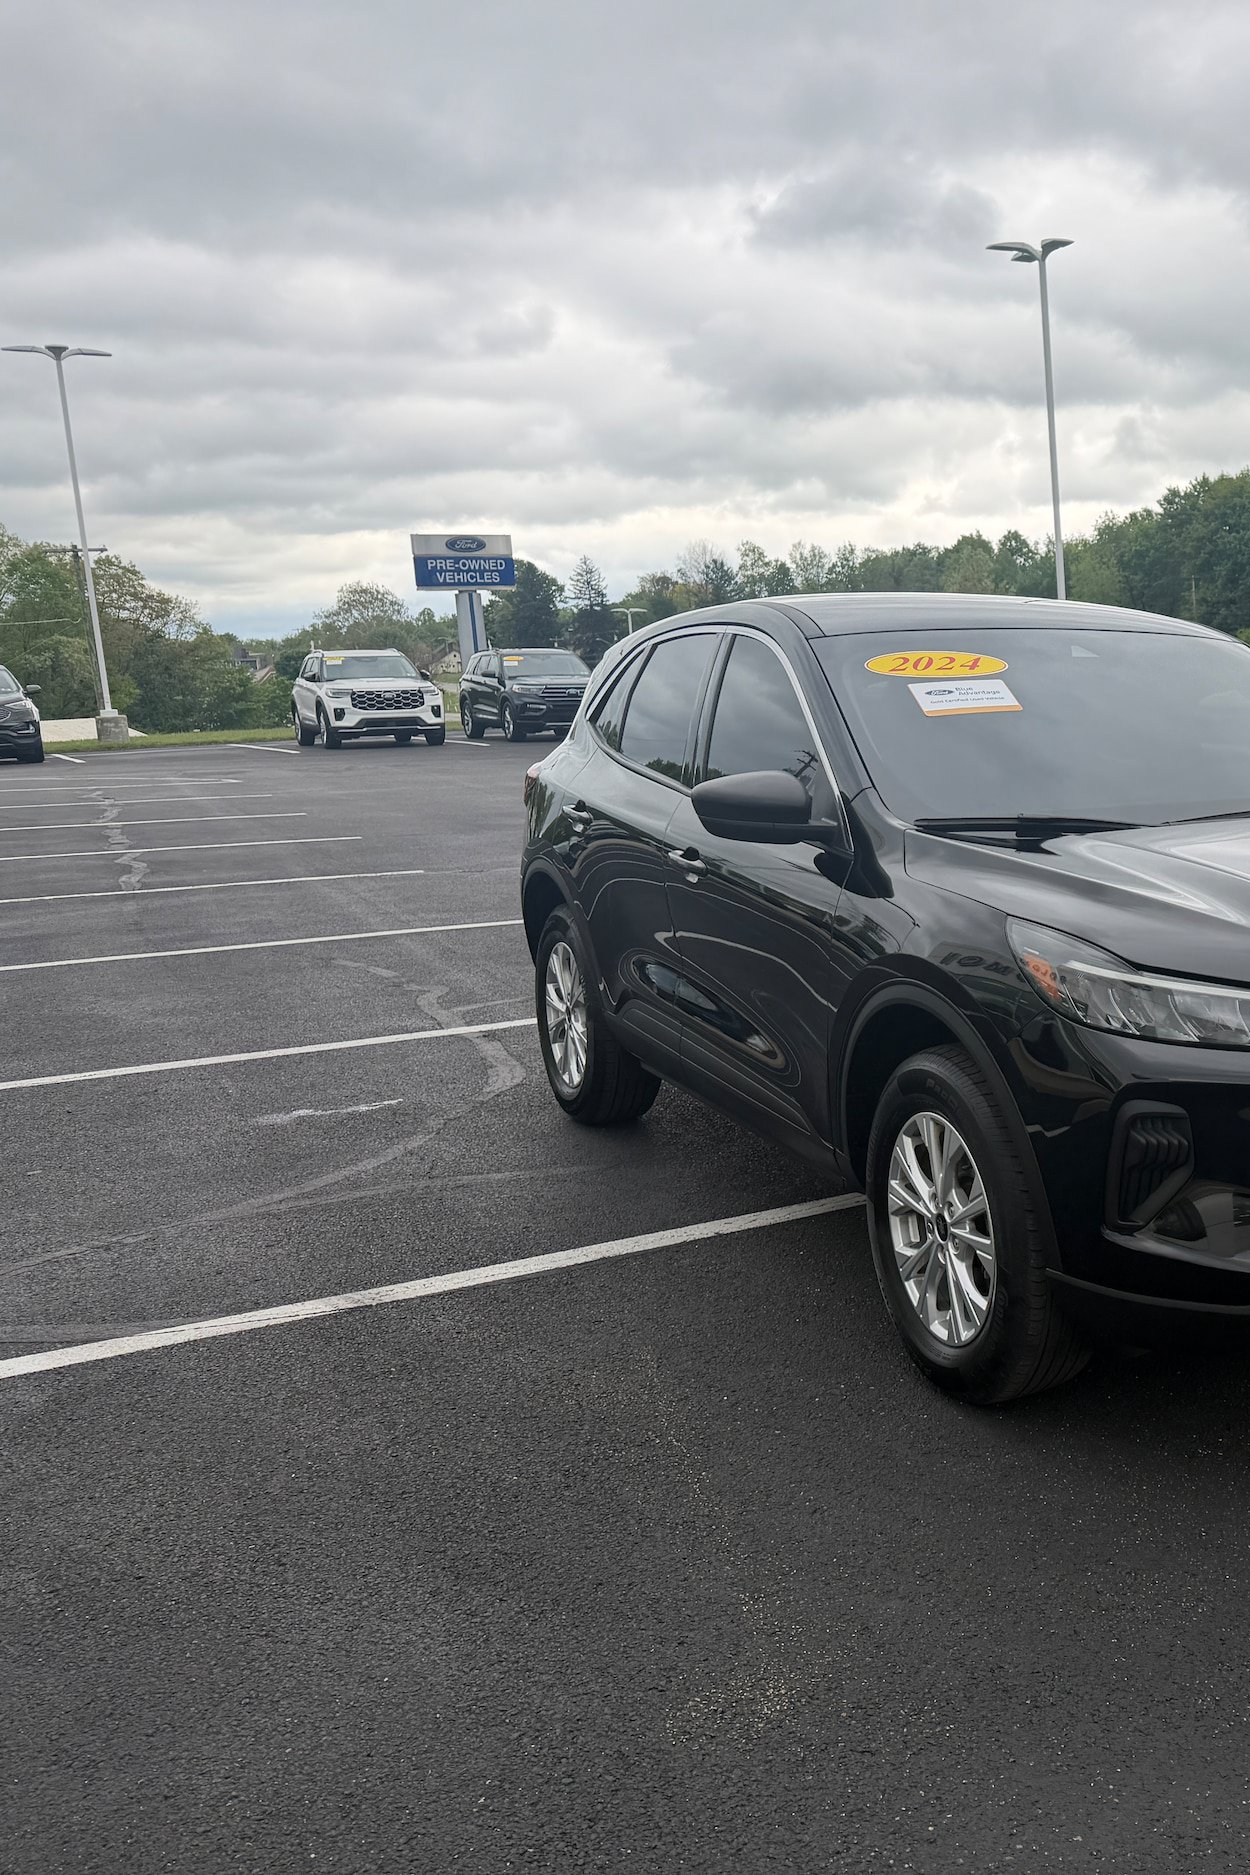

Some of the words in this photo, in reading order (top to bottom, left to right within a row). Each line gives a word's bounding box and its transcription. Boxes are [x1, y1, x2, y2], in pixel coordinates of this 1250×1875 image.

[427, 559, 506, 571] PRE-OWNED
[436, 572, 500, 583] VEHICLES
[888, 656, 982, 673] 2024
